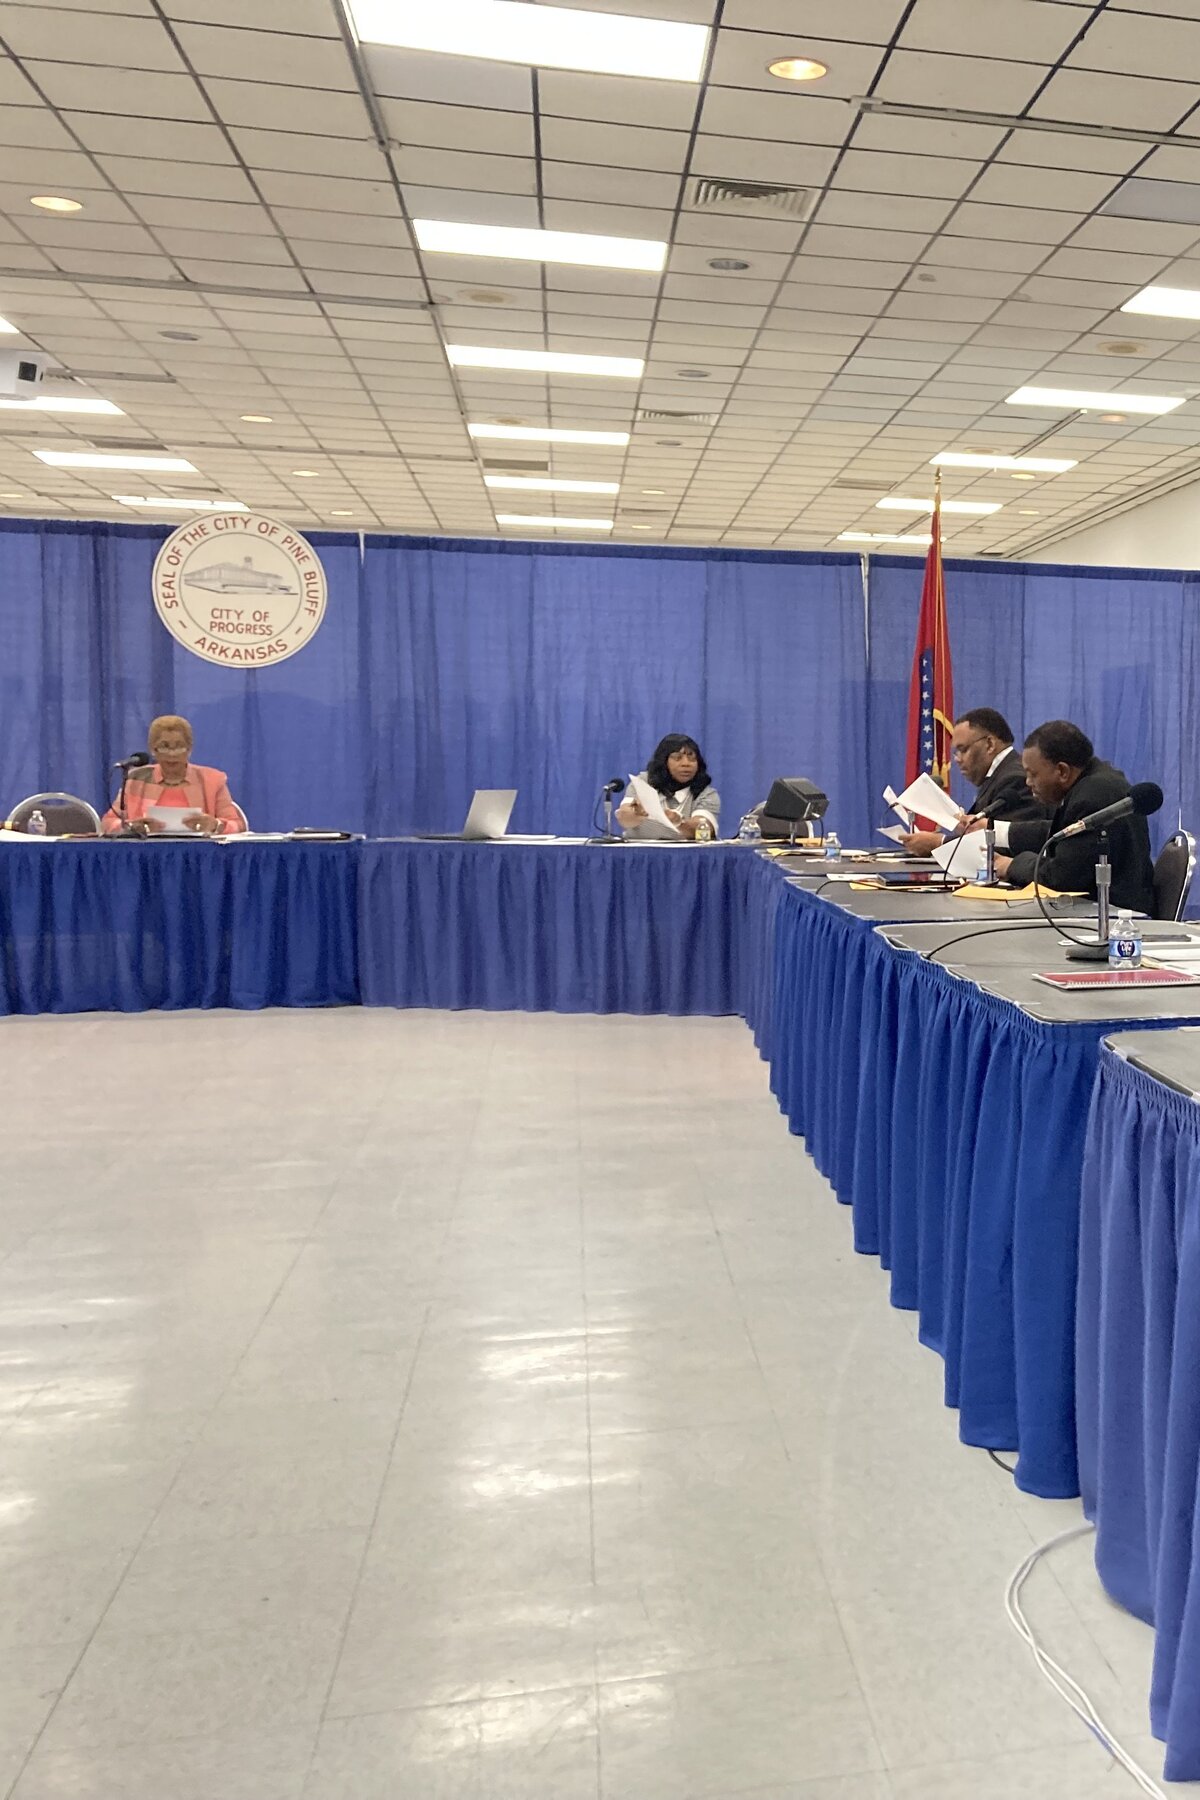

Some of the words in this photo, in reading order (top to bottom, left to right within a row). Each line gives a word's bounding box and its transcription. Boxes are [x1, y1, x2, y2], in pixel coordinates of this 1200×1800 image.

[213, 516, 252, 531] CITY
[257, 521, 280, 536] OF
[179, 523, 210, 546] THE
[166, 546, 184, 566] OF
[281, 535, 311, 565] PINE
[161, 571, 179, 609] SEAL
[303, 571, 319, 617] BLUFF
[210, 607, 244, 620] CITY
[252, 610, 270, 622] OF
[209, 621, 273, 636] PROGRESS
[194, 636, 288, 660] ARKANSAS
